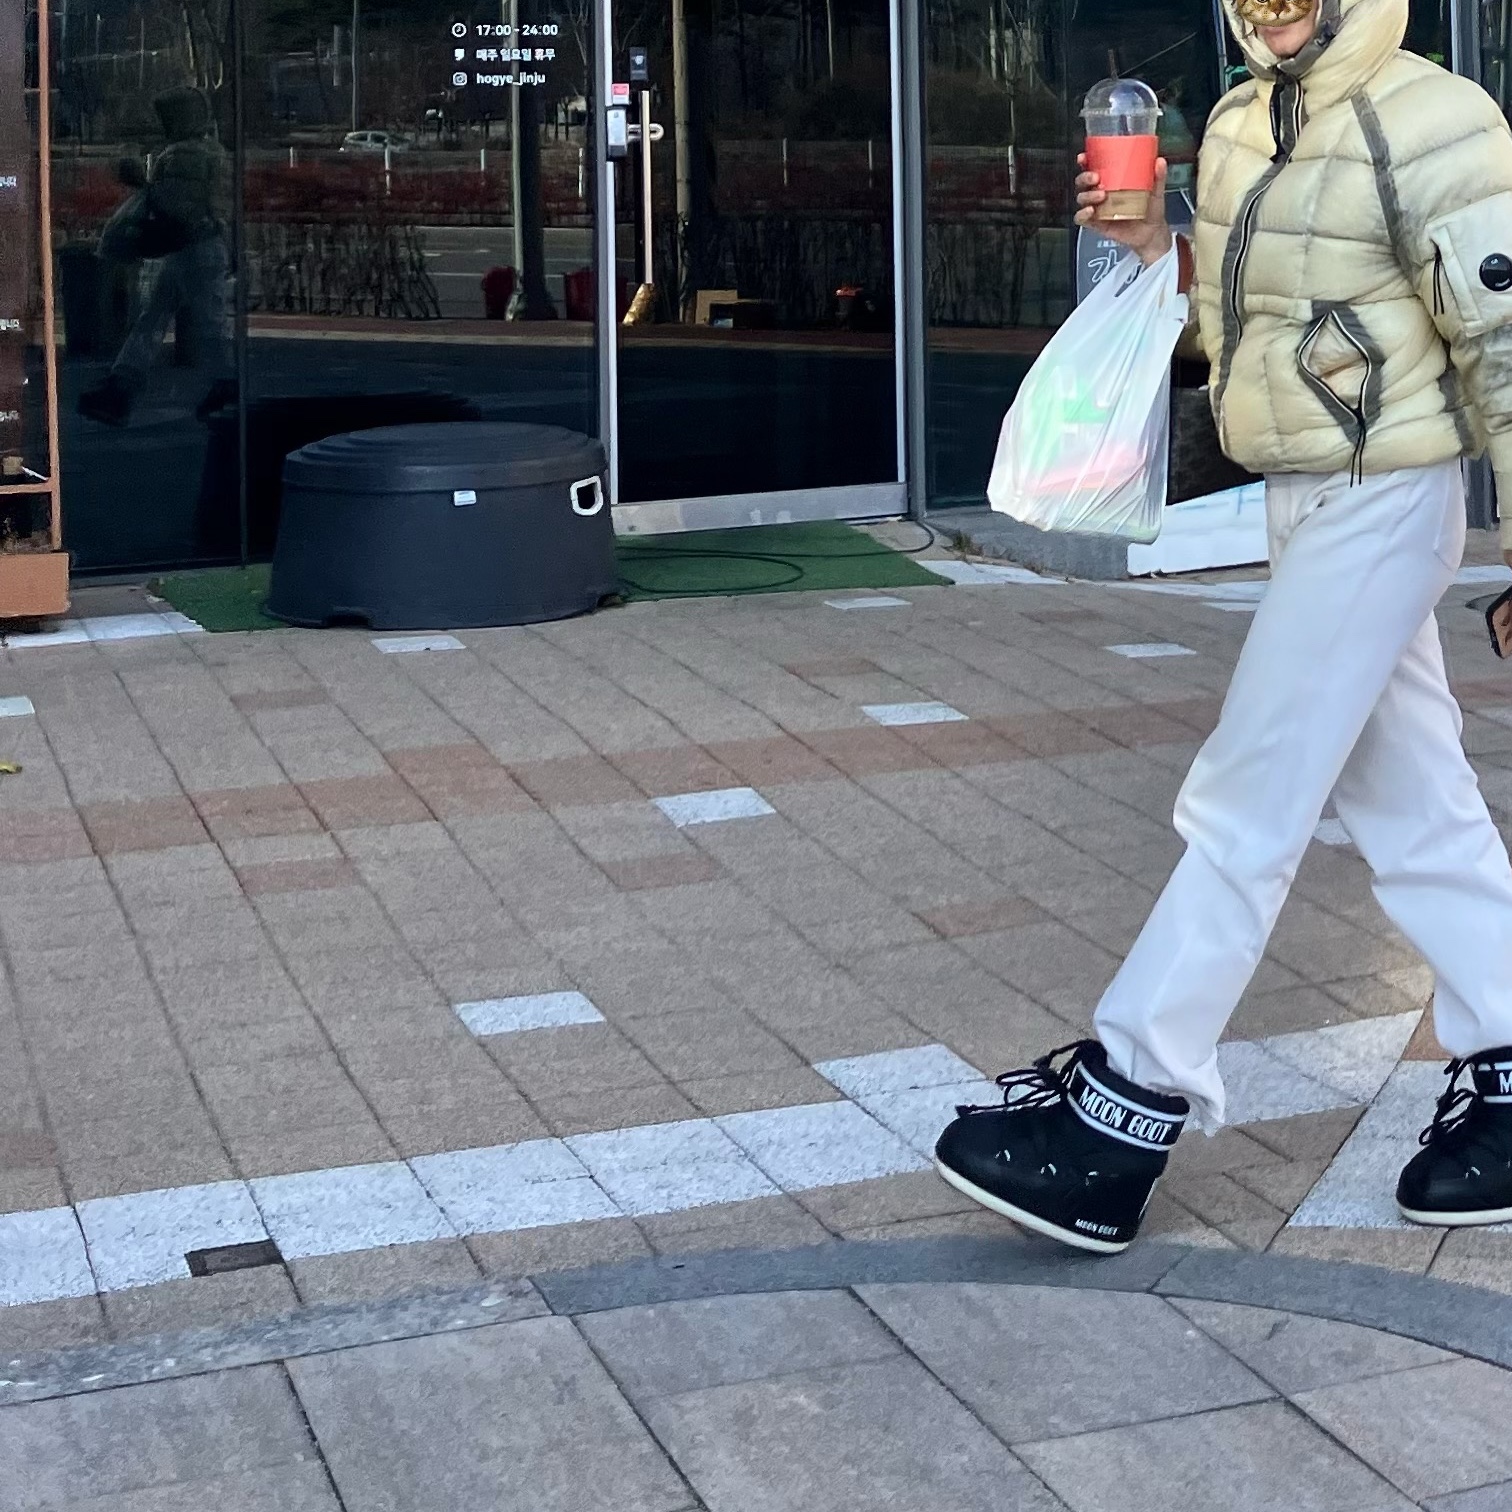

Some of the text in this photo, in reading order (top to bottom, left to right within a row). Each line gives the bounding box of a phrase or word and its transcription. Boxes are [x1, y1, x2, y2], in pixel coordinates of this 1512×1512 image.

[475, 24, 511, 36] 17:00
[522, 24, 559, 36] 24:00
[475, 48, 556, 62] 매주 일요일 휴무
[476, 71, 546, 86] hogye_jinju
[1078, 1086, 1172, 1143] MOON BOOT
[1075, 1218, 1119, 1236] MOON BOOT
